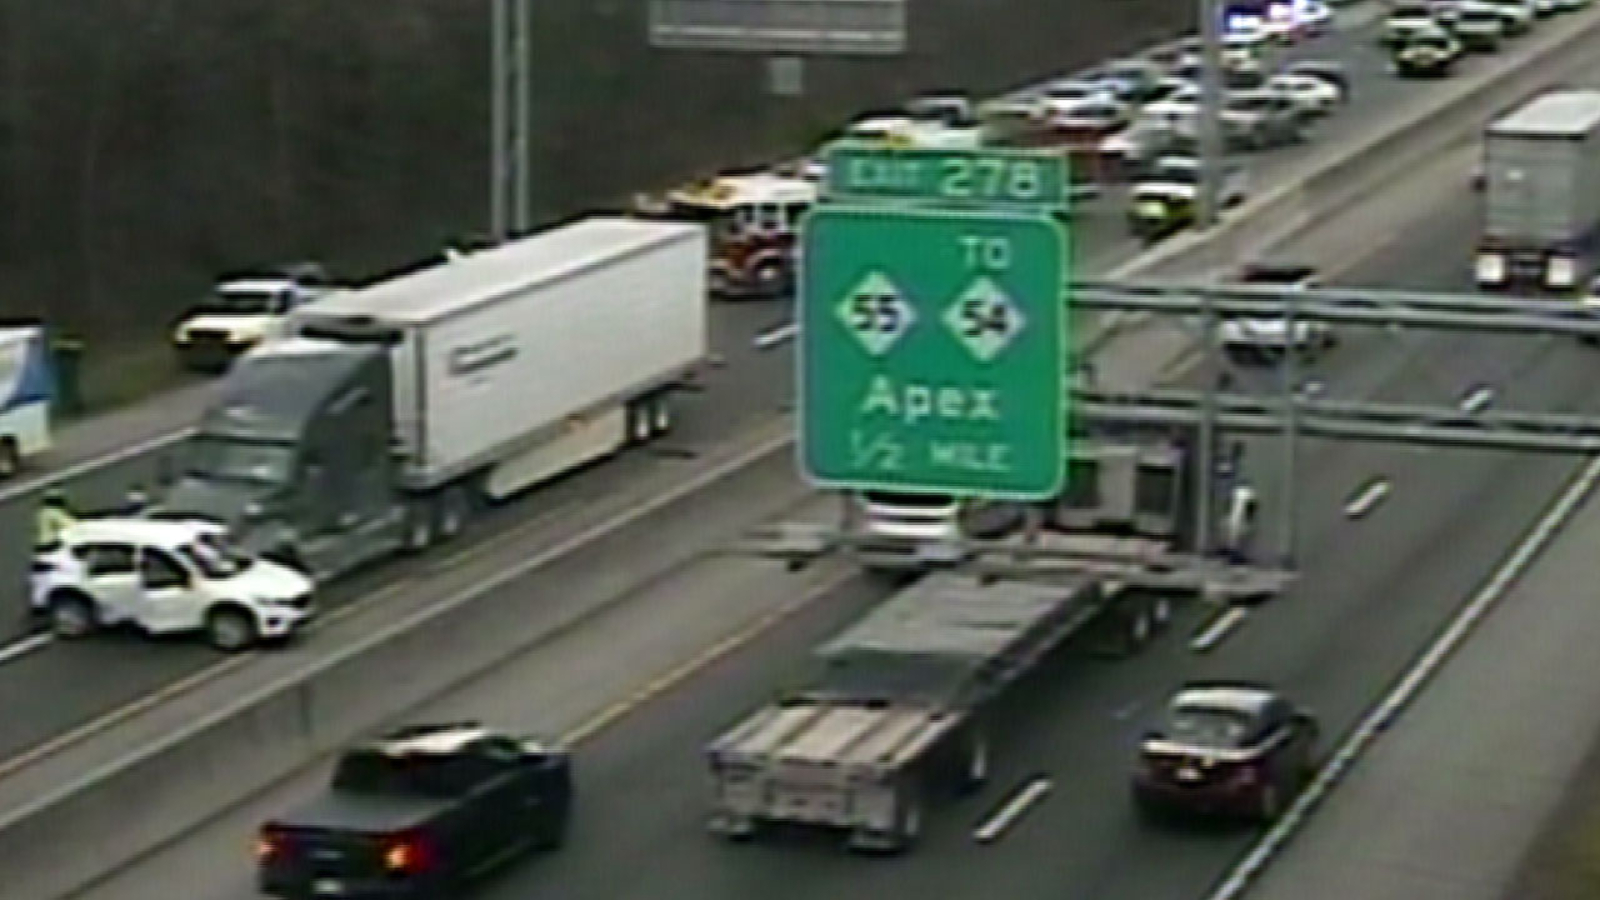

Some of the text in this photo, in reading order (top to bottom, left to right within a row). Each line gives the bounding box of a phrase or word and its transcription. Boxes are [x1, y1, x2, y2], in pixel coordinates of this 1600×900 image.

[941, 159, 1040, 197] 278
[958, 235, 1011, 270] TO
[852, 294, 899, 333] 55
[962, 299, 1005, 338] 54
[862, 374, 1000, 427] Apex
